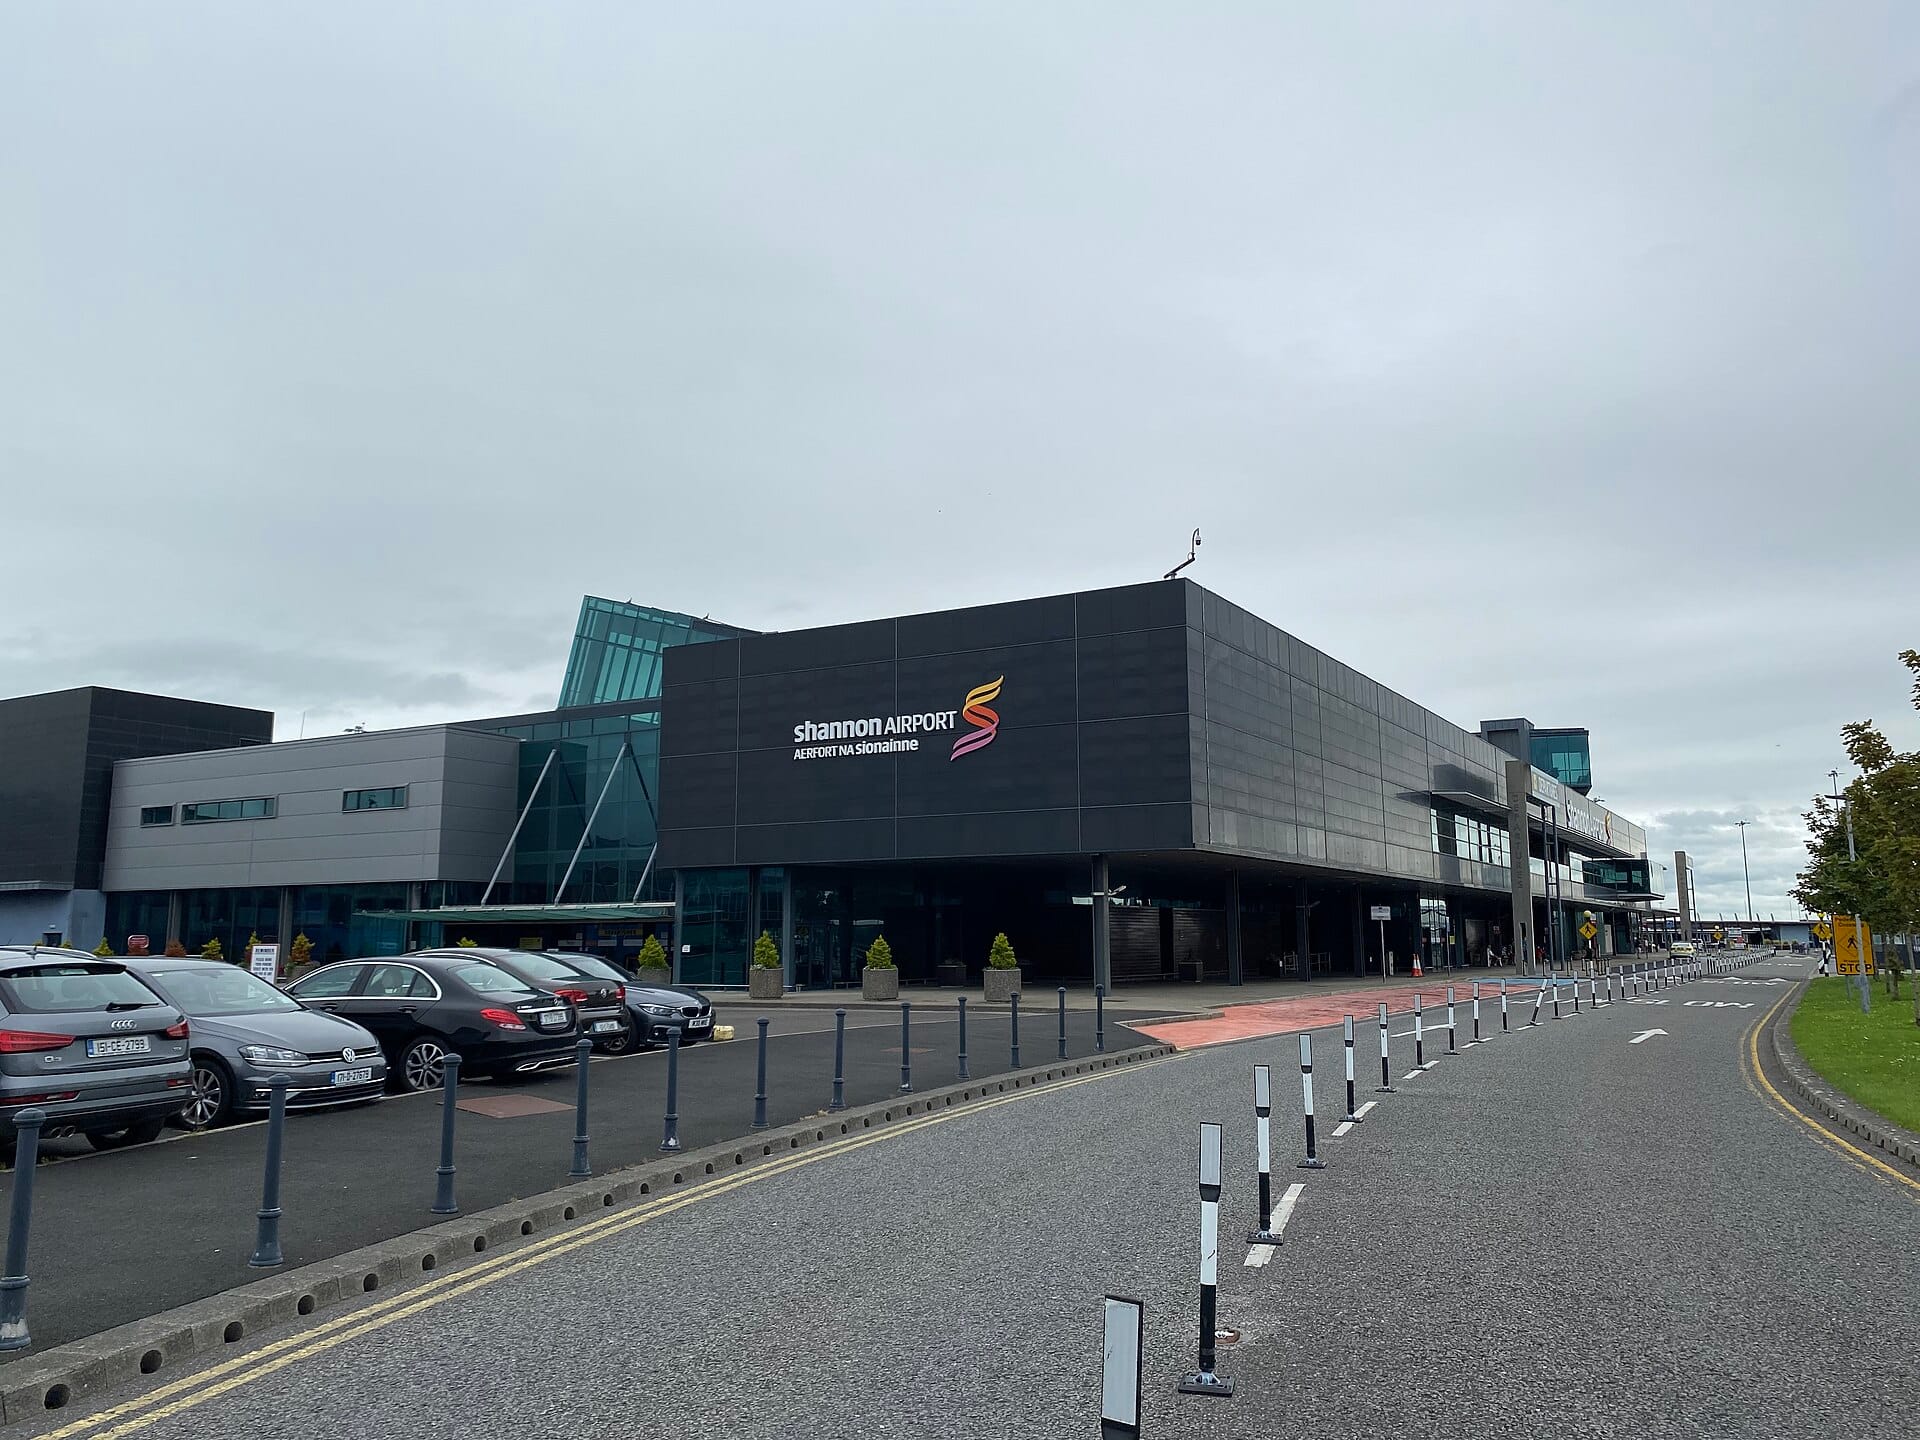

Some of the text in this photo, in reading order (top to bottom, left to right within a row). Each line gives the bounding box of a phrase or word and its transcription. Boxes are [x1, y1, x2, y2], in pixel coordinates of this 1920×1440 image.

[794, 711, 958, 743] shannon AIRPORT
[793, 738, 919, 760] AERFORT NA sionainne
